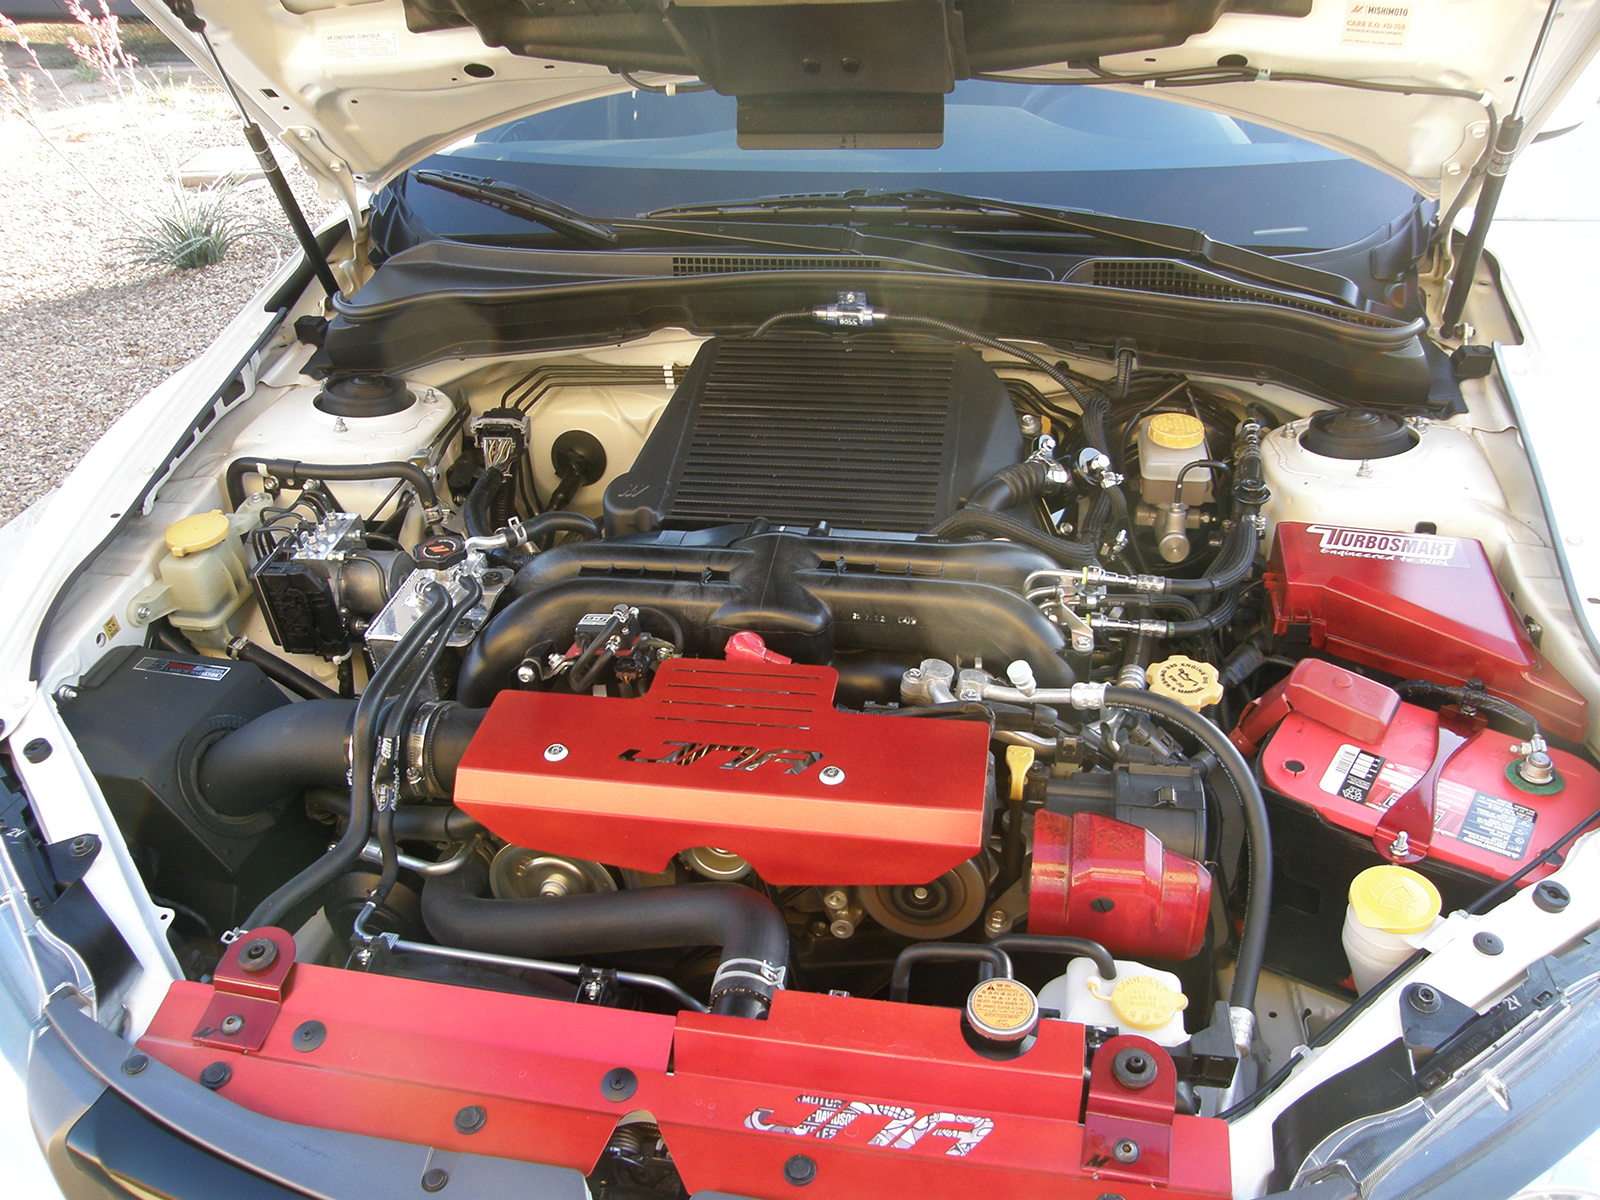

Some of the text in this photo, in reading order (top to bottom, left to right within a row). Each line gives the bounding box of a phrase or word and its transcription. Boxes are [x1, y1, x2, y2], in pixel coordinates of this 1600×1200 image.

[1367, 6, 1409, 17] MISHIMOTO
[1308, 524, 1457, 560] TURBOSMART
[1320, 548, 1396, 562] Engineered
[1399, 555, 1414, 563] to
[1180, 662, 1206, 676] ENGINE
[1177, 686, 1205, 694] MANUAL
